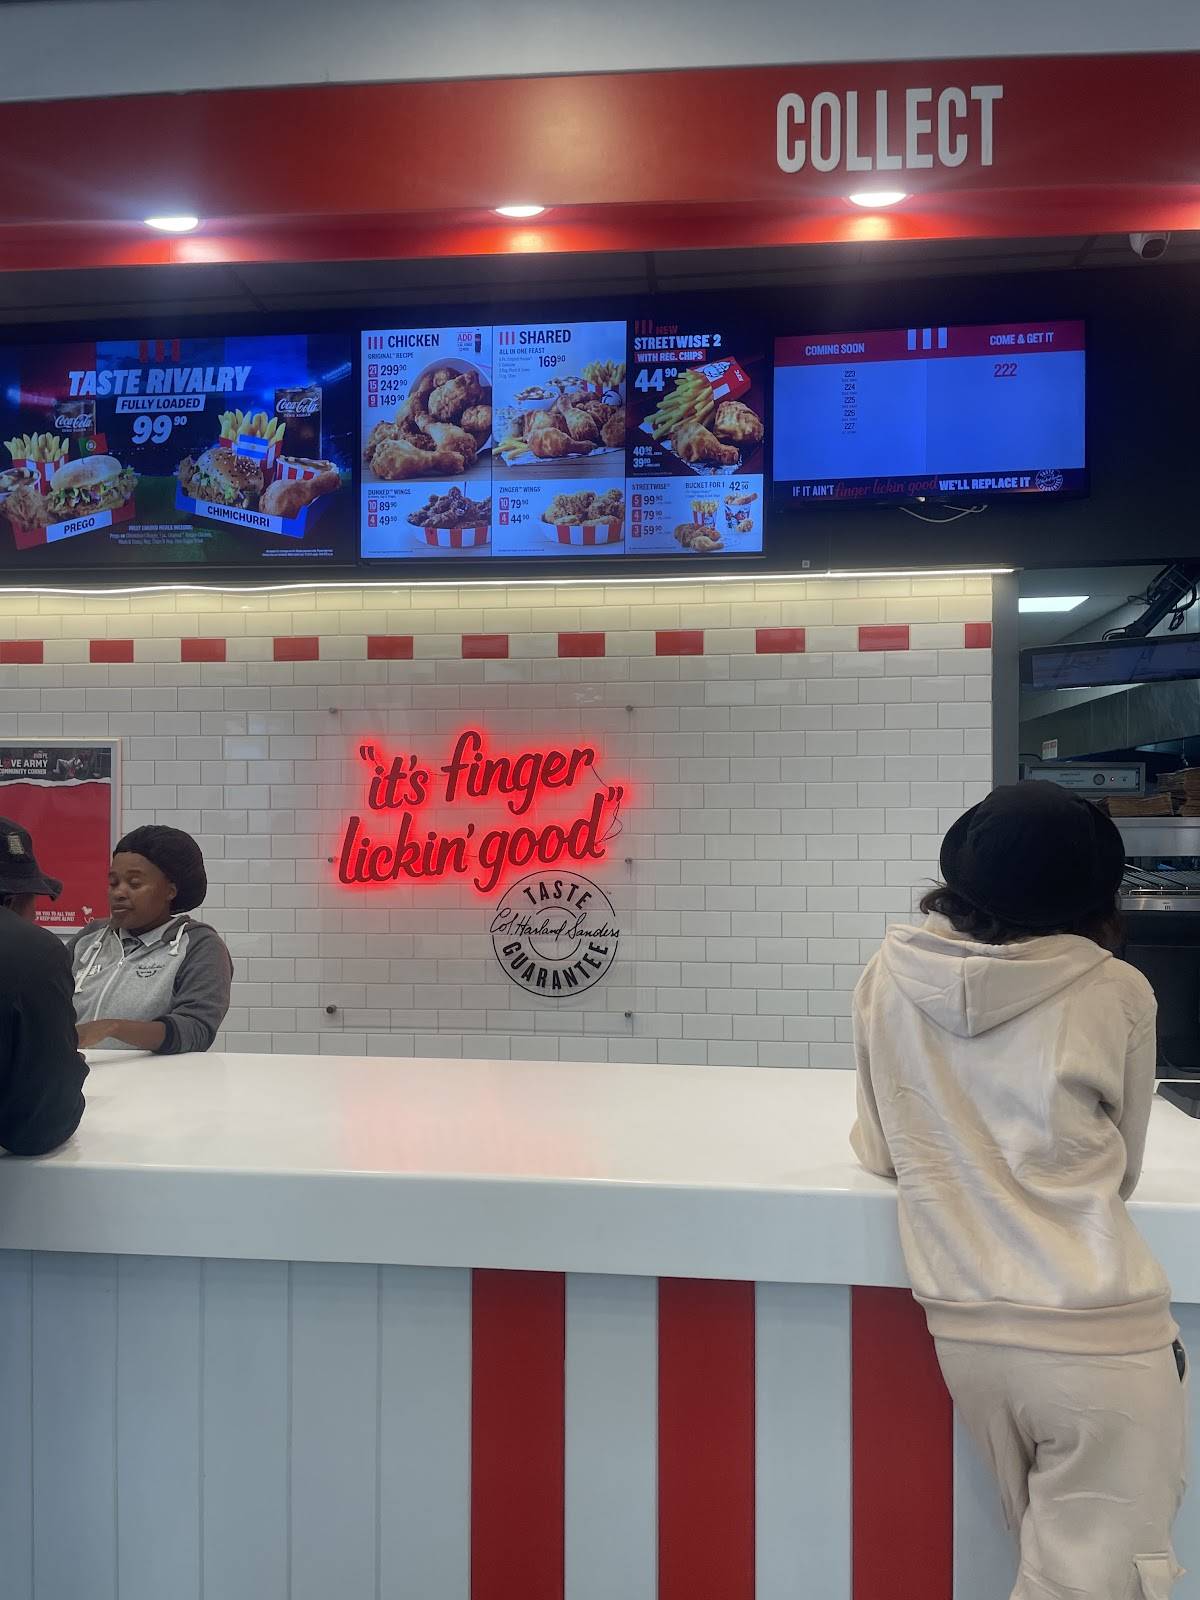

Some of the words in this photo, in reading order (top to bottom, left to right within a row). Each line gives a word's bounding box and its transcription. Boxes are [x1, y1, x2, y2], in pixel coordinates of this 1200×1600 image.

[776, 85, 1003, 173] COLLECT
[387, 333, 440, 348] CHICKEN
[457, 334, 472, 342] ADD
[519, 329, 571, 345] SHARED
[634, 335, 709, 350] STREETWISE
[713, 333, 721, 347] 2
[990, 334, 1015, 346] COME
[1017, 333, 1025, 344] &
[1026, 333, 1043, 344] GET
[1045, 332, 1054, 343] IT
[637, 352, 658, 362] WITH
[660, 352, 677, 361] REG.
[678, 351, 703, 361] CHIPS
[805, 344, 839, 356] COMING
[840, 343, 865, 354] SOON
[994, 363, 1017, 377] 222
[69, 369, 143, 396] TASTE
[146, 366, 251, 394] RIVALRY
[121, 399, 153, 410] FULLY
[156, 398, 200, 409] LOADED
[793, 486, 800, 497] IF
[802, 486, 810, 496] IT
[812, 485, 834, 496] AIN'T
[908, 475, 937, 496] good
[939, 479, 970, 491] WE'LL
[971, 478, 1018, 490] REPLACE
[1020, 476, 1031, 487] IT
[207, 505, 270, 528] CHIMICHURRI
[64, 518, 95, 534] PREGO
[24, 759, 48, 768] ARMY
[441, 730, 595, 816] finger
[338, 812, 475, 885] lickin'
[523, 880, 592, 910] TASTE
[503, 941, 609, 990] GUARANTEE
